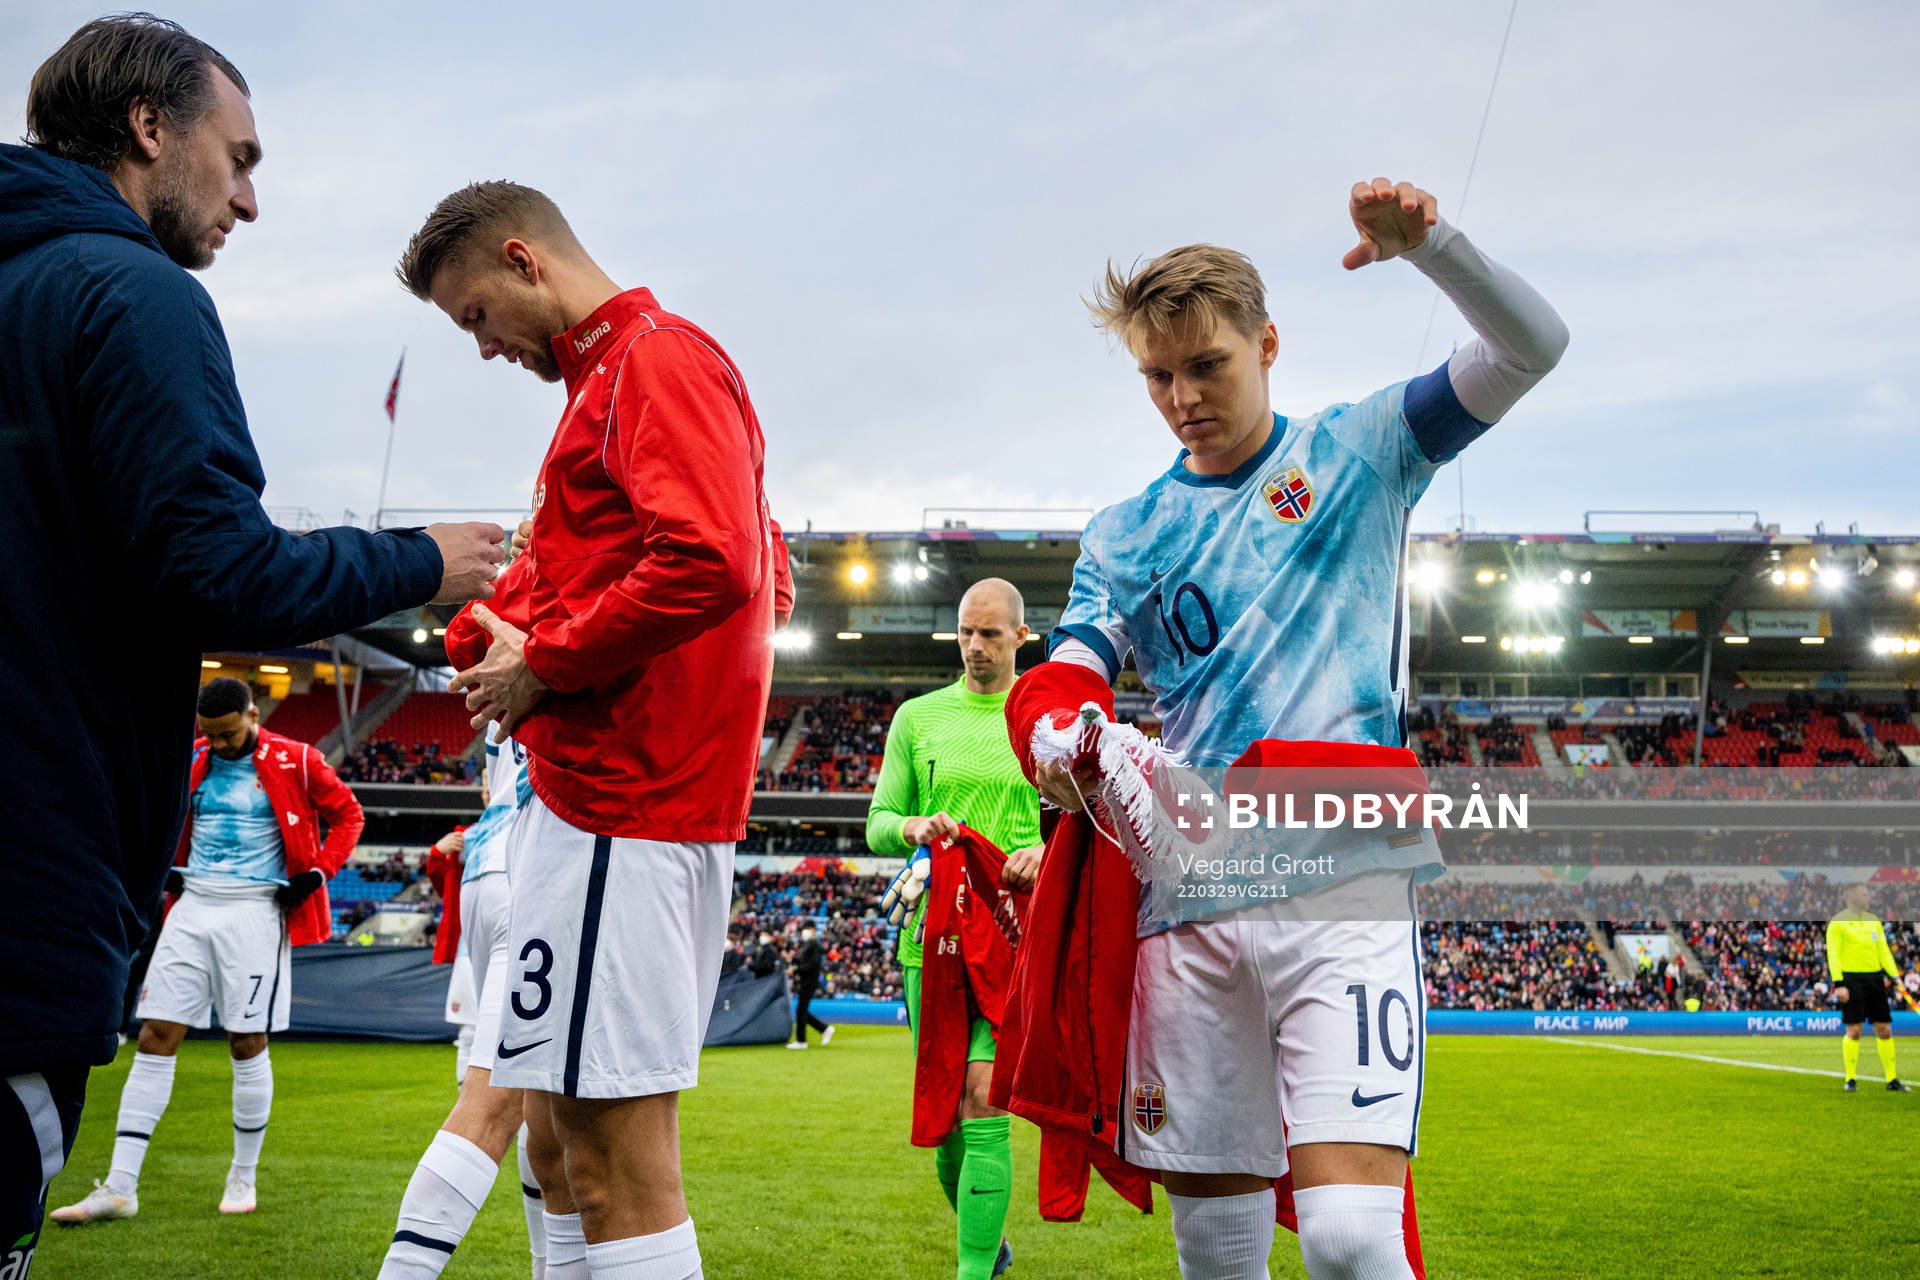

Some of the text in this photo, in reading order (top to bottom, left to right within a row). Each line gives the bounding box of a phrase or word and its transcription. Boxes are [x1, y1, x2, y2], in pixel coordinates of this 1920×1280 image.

[573, 320, 611, 354] bama
[1154, 581, 1219, 667] 10
[928, 760, 936, 799] 1
[248, 975, 263, 1005] 7
[511, 938, 554, 1021] 3
[1345, 984, 1414, 1071] 10
[1534, 1016, 1579, 1031] PEACE
[1747, 1016, 1792, 1031] PEACE
